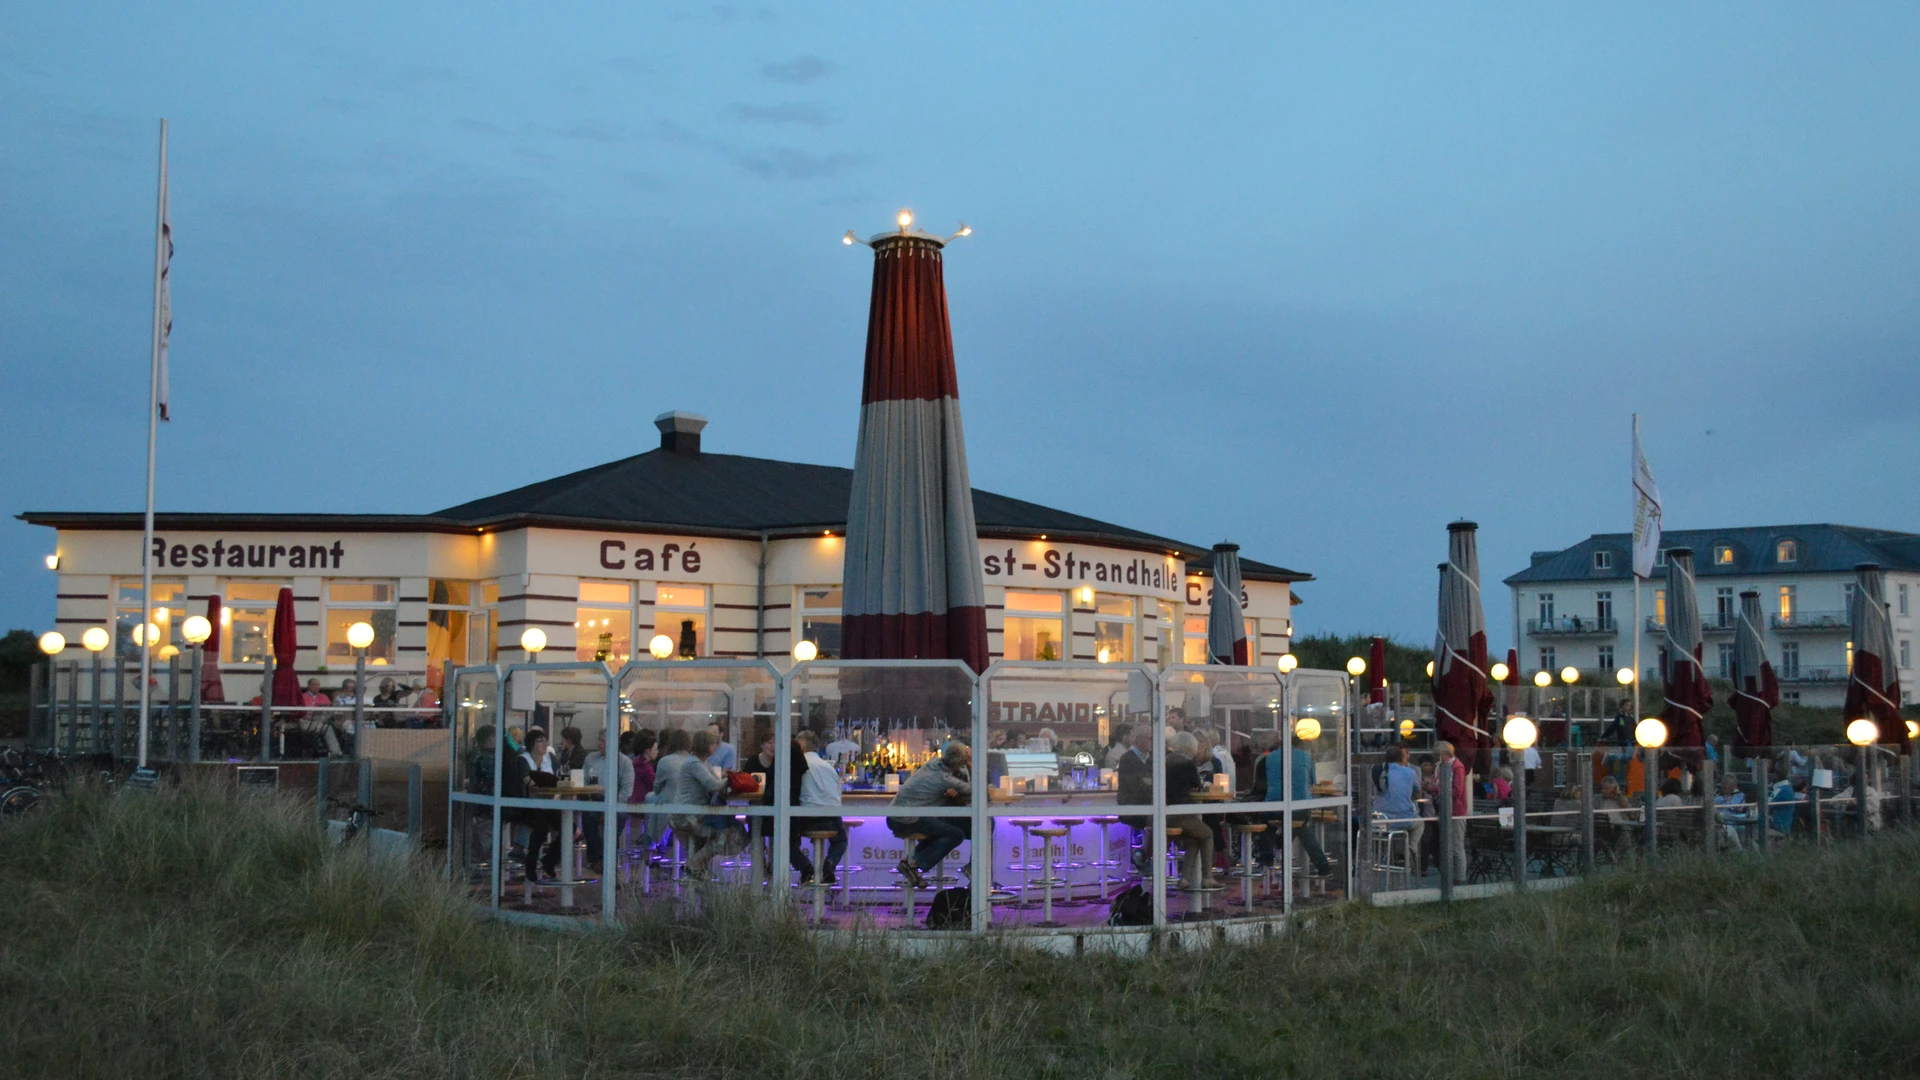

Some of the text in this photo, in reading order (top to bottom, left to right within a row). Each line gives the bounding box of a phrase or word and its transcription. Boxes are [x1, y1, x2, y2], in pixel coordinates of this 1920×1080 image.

[143, 537, 344, 569] Restaurant
[600, 539, 702, 574] Café
[984, 548, 1178, 592] st-Strandhalle
